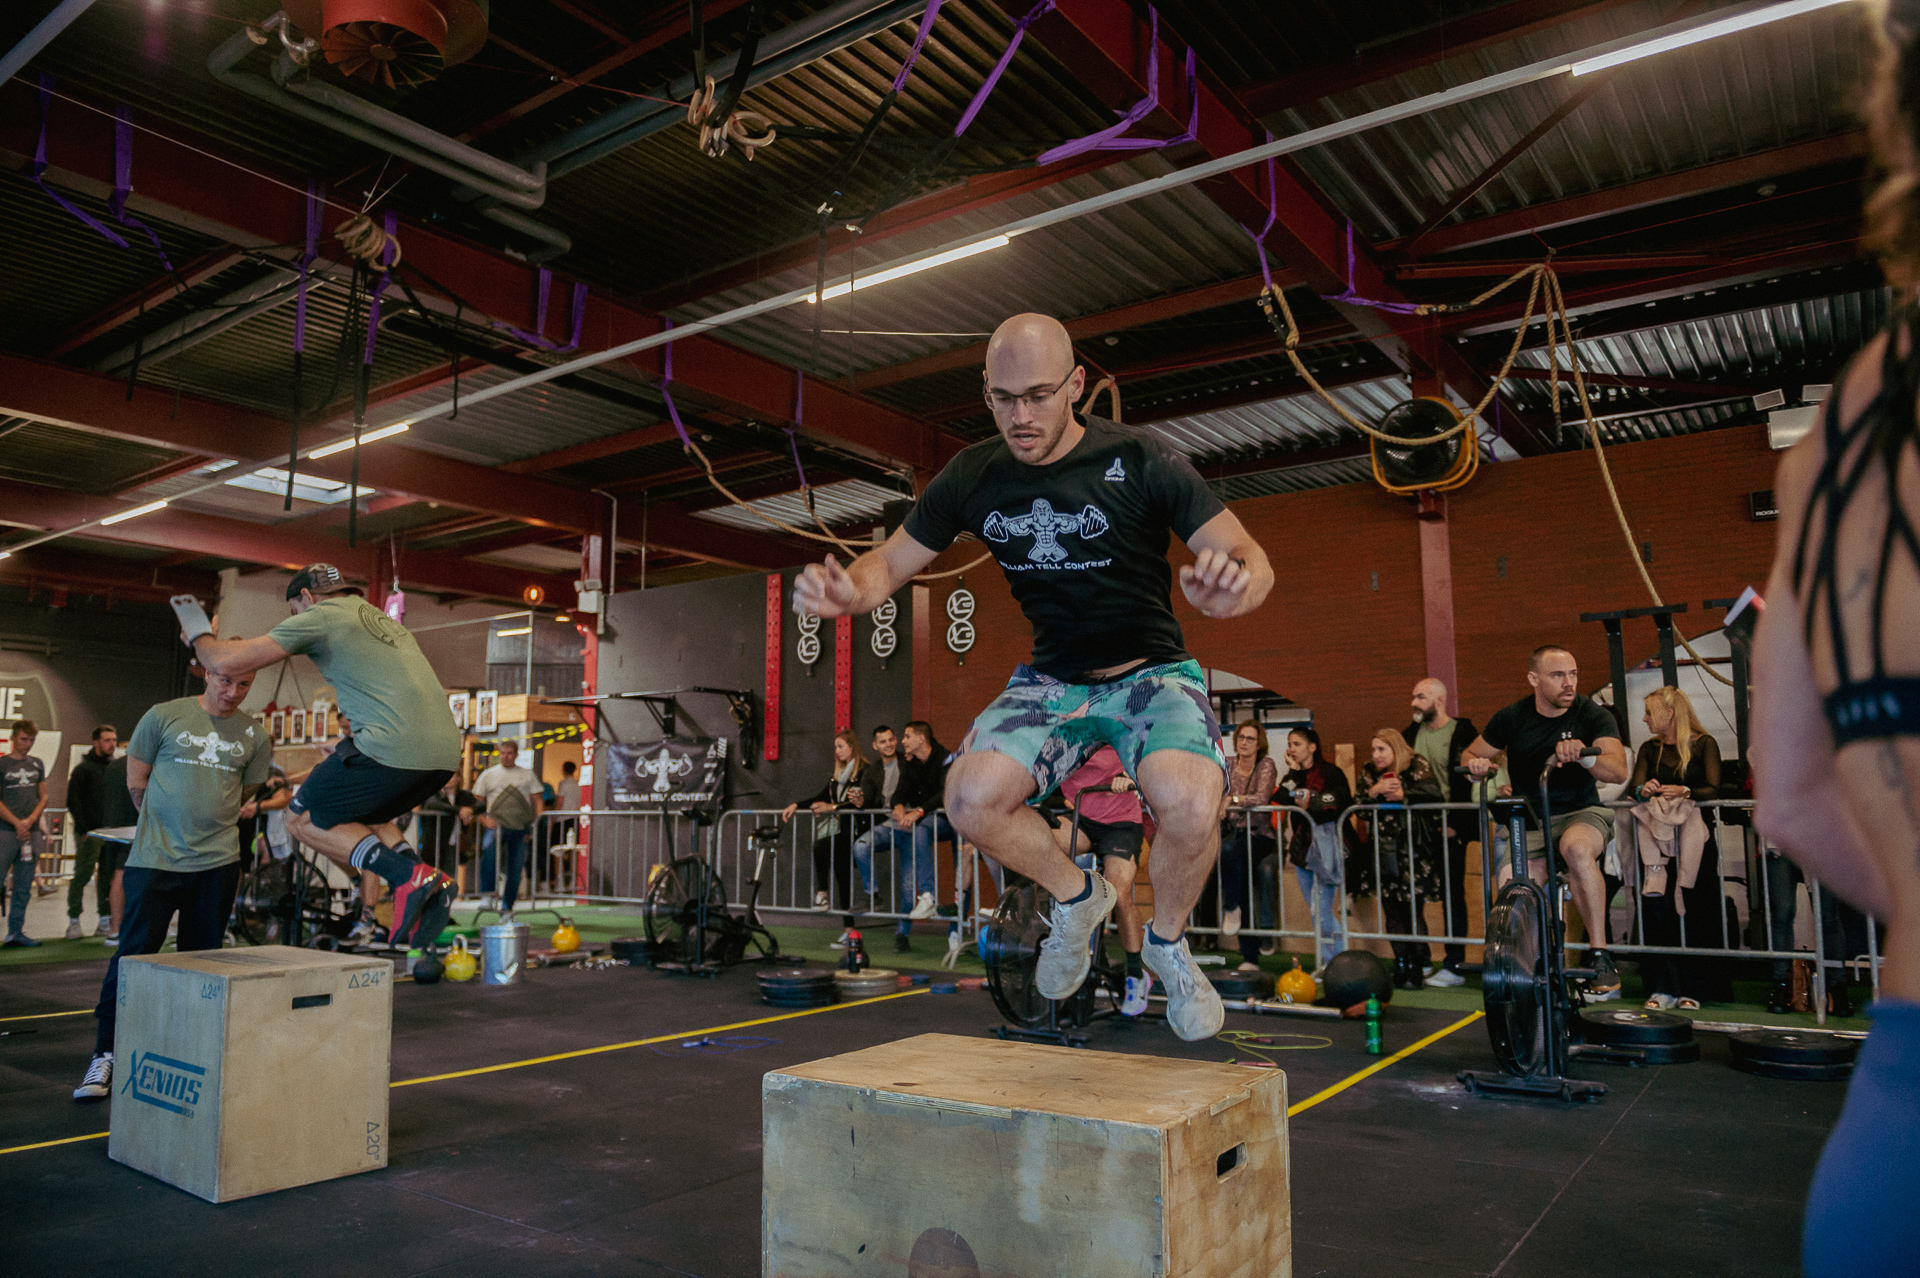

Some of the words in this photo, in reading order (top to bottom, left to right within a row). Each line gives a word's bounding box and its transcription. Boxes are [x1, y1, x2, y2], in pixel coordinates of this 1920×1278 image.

[1064, 558, 1112, 570] CONTEST
[613, 793, 649, 803] WILLIAM
[670, 792, 713, 802] CONTEST
[121, 1049, 204, 1106] XENIOS
